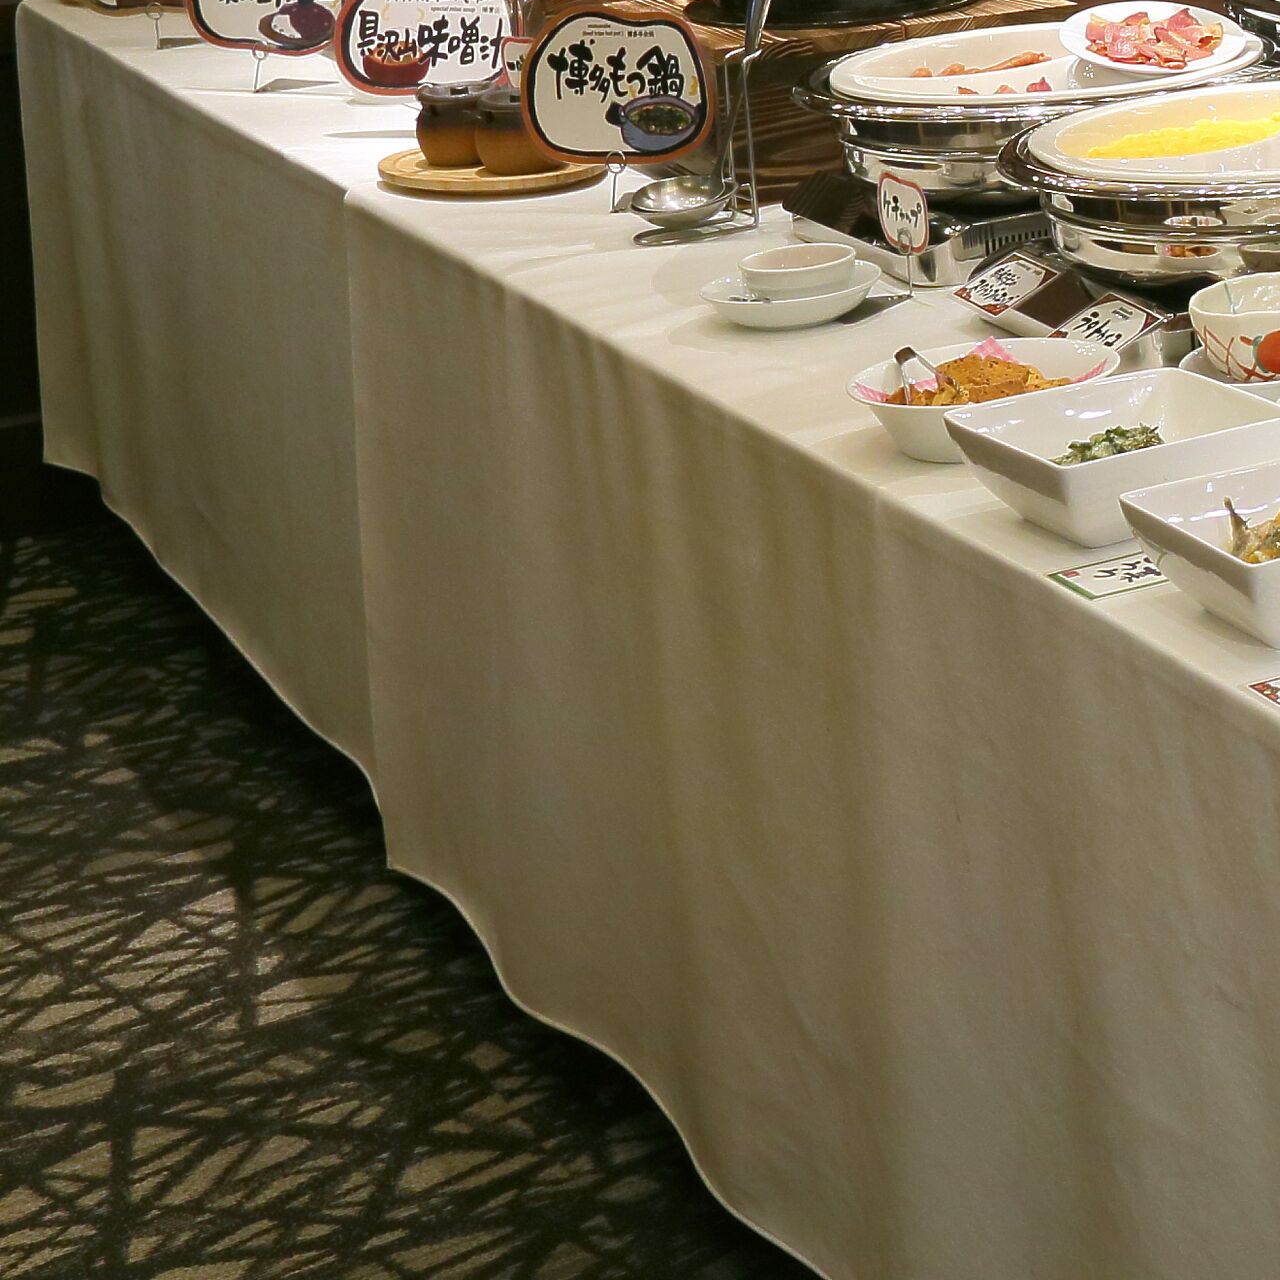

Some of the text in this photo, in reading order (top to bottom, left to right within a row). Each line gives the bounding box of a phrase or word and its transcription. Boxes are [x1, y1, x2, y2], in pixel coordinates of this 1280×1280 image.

[357, 10, 503, 69] 具沢山味噌汁
[547, 38, 685, 104] 博多もつ鍋
[882, 190, 922, 228] ケチャップ
